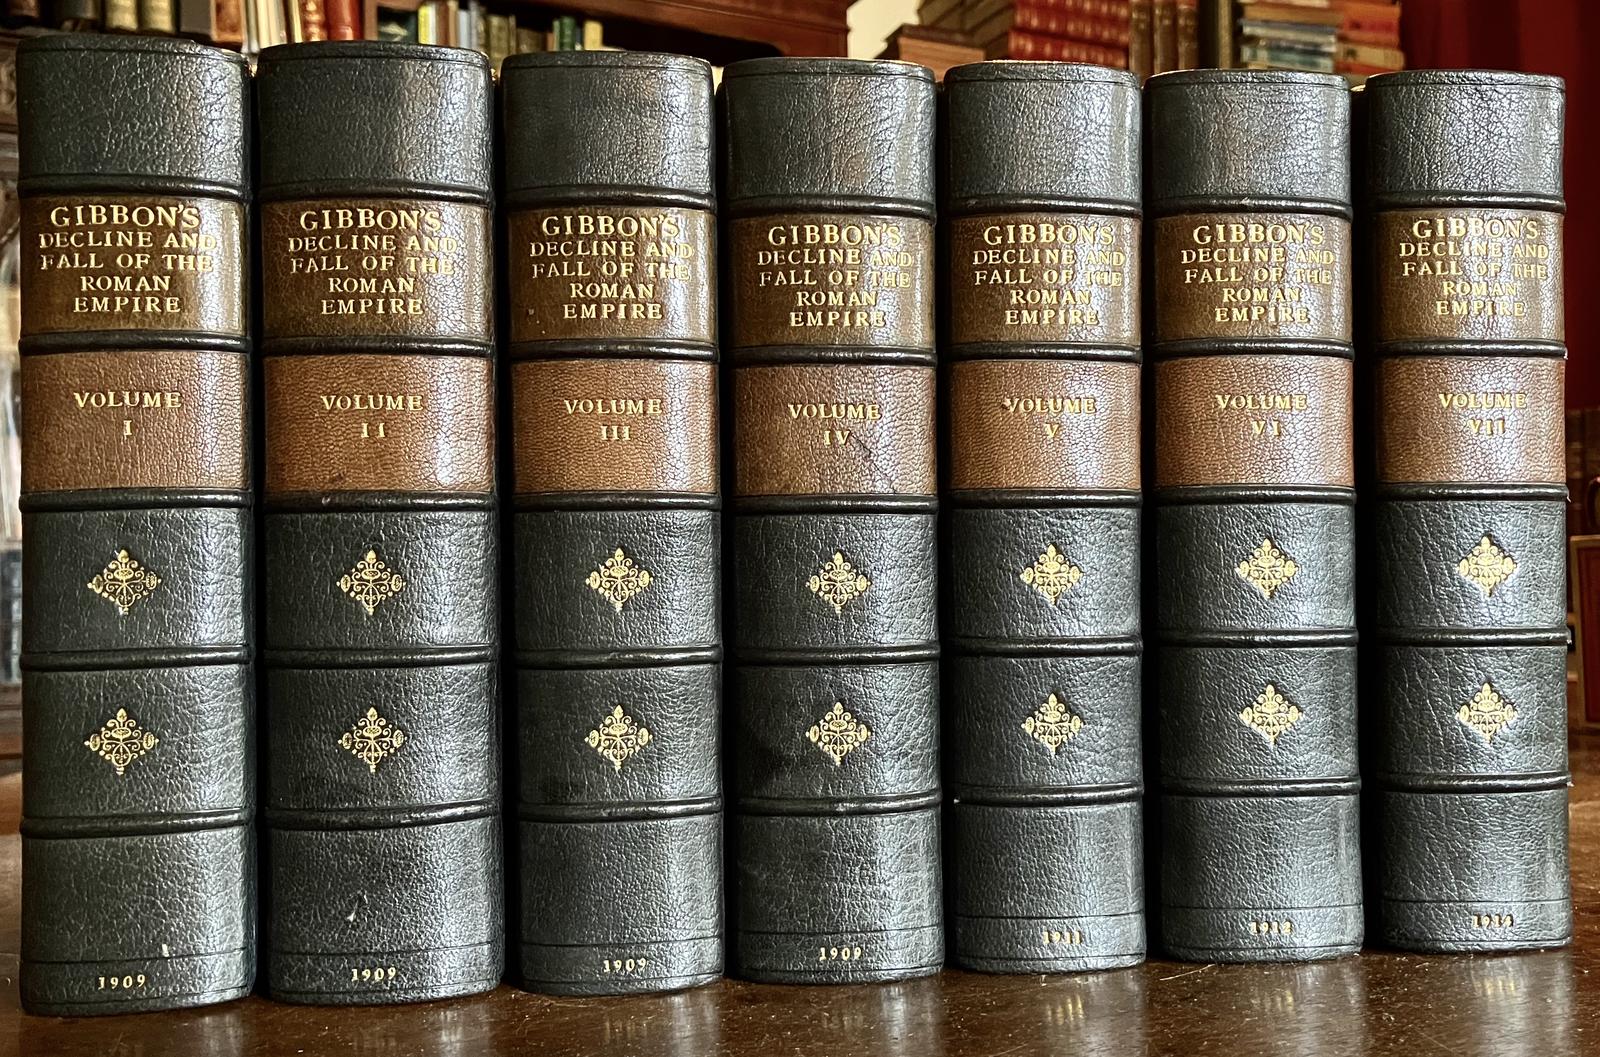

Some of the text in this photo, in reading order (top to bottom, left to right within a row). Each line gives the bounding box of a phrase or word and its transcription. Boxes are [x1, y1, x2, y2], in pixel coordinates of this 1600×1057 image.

[50, 204, 199, 229] GIBBON'S
[300, 208, 442, 232] GIBBON'S
[541, 214, 680, 239] GIBBON'S
[768, 223, 901, 246] GIBBON'S
[1193, 222, 1325, 246] GIBBON'S
[1412, 217, 1539, 239] GIBBON'S
[39, 231, 216, 250] DECLINE AND
[288, 234, 458, 253] DECLINE AND
[530, 240, 694, 259] DECLINE AND
[757, 248, 913, 267] DECLINE AND
[973, 249, 1126, 267] DECLINE AND
[1181, 248, 1334, 265] DECLINE AND
[1400, 242, 1549, 260] DECLINE AND
[40, 253, 214, 272] FALL OF THE
[290, 256, 454, 275] FALL OF THE
[532, 261, 691, 281] FALL OF THE
[1402, 261, 1548, 280] FALL OF THE
[80, 275, 171, 292] ROMAN
[759, 270, 911, 288] FALL OF THE
[974, 269, 1122, 287] FALL OF THE
[1184, 267, 1332, 285] FALL OF THE
[328, 277, 415, 294] ROMAN
[570, 282, 655, 299] ROMAN
[1443, 281, 1517, 296] ROMAN
[796, 291, 878, 307] ROMAN
[1010, 289, 1092, 306] ROMAN
[1222, 288, 1300, 302] ROMAN
[73, 297, 181, 313] EMPIRE
[321, 299, 424, 315] EMPIRE
[563, 303, 663, 320] EMPIRE
[1436, 301, 1526, 317] EMPIRE
[790, 311, 886, 327] EMPIRE
[1005, 309, 1099, 325] EMPIRE
[1215, 306, 1311, 323] EMPIRE
[74, 391, 182, 408] VOLUME
[320, 394, 424, 411] VOLUME
[564, 399, 663, 415] VOLUME
[1006, 398, 1097, 414] VOLUME
[1215, 394, 1308, 410] VOLUME
[1439, 393, 1527, 409] VOLUME
[788, 403, 881, 420] VOLUME
[123, 419, 133, 436] I
[361, 422, 386, 438] II
[600, 425, 631, 440] III
[1044, 423, 1059, 437] V
[1251, 420, 1282, 436] VI
[1468, 419, 1505, 436] VII
[823, 430, 851, 446] IV
[819, 946, 862, 961] 1909
[603, 957, 647, 973] 1909
[98, 974, 146, 990] 1909
[351, 967, 396, 981] 1909
